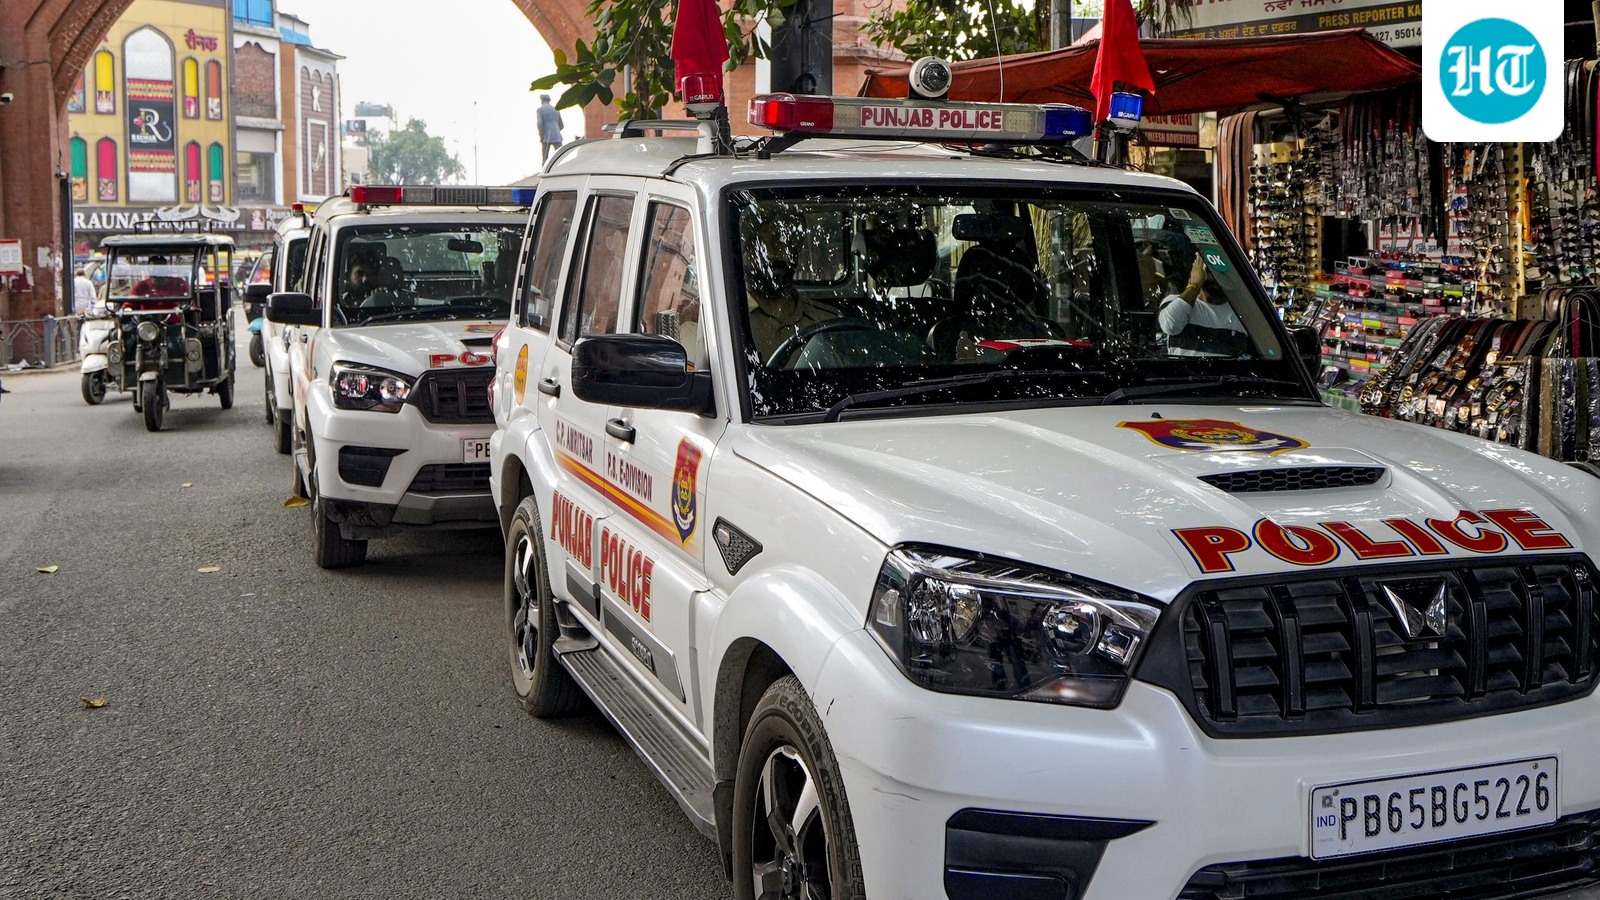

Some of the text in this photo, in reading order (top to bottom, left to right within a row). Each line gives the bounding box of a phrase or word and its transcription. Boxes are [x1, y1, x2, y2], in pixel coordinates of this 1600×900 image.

[1259, 24, 1269, 34] ਦਾ
[1318, 14, 1350, 28] PRESS
[1352, 7, 1405, 24] REPORTER
[184, 28, 218, 52] रौनक
[861, 107, 1002, 130] PUNJAB POLICE
[73, 210, 156, 230] RAUNAK
[266, 209, 291, 221] Rauna
[1206, 253, 1226, 267] OK
[556, 420, 593, 465] C.P. AMRITSAR
[607, 451, 652, 503] P.S. E-DIVISION
[1171, 508, 1574, 574] POLICE
[551, 490, 654, 623] PUNJAB POLICE
[1339, 771, 1550, 841] PB65BG5226
[1316, 814, 1336, 828] IND
